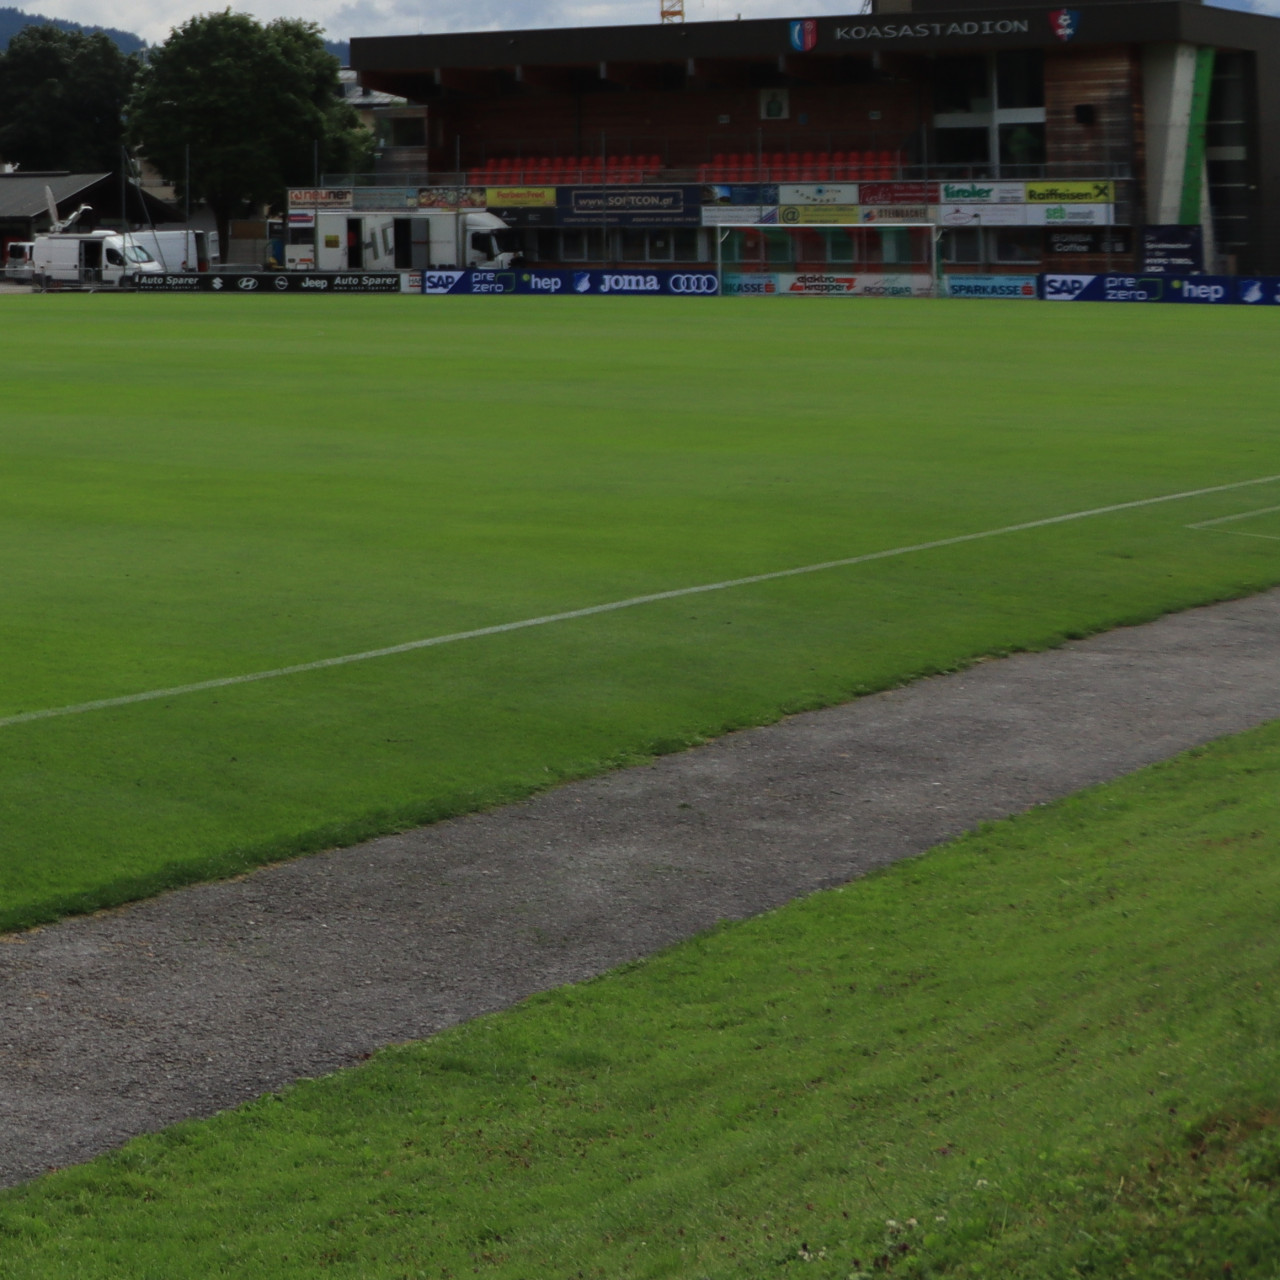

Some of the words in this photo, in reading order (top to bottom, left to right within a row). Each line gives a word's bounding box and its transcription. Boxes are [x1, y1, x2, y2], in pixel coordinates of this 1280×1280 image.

[835, 20, 1028, 40] KOASASTADION
[303, 190, 351, 200] neuner
[1028, 188, 1092, 201] Raiffeisen
[141, 276, 163, 284] Auto
[166, 276, 199, 286] Sparer
[334, 277, 358, 285] Auto
[362, 276, 398, 286] Sparer
[427, 275, 454, 289] SAP
[472, 272, 495, 282] pre
[1105, 277, 1136, 287] pre
[302, 277, 328, 289] Jeep
[472, 283, 504, 292] zero
[531, 274, 562, 292] hep
[1047, 279, 1083, 295] SAP
[951, 285, 1021, 295] SPARKASSE
[1105, 290, 1148, 300] zero
[1183, 280, 1224, 302] hep
